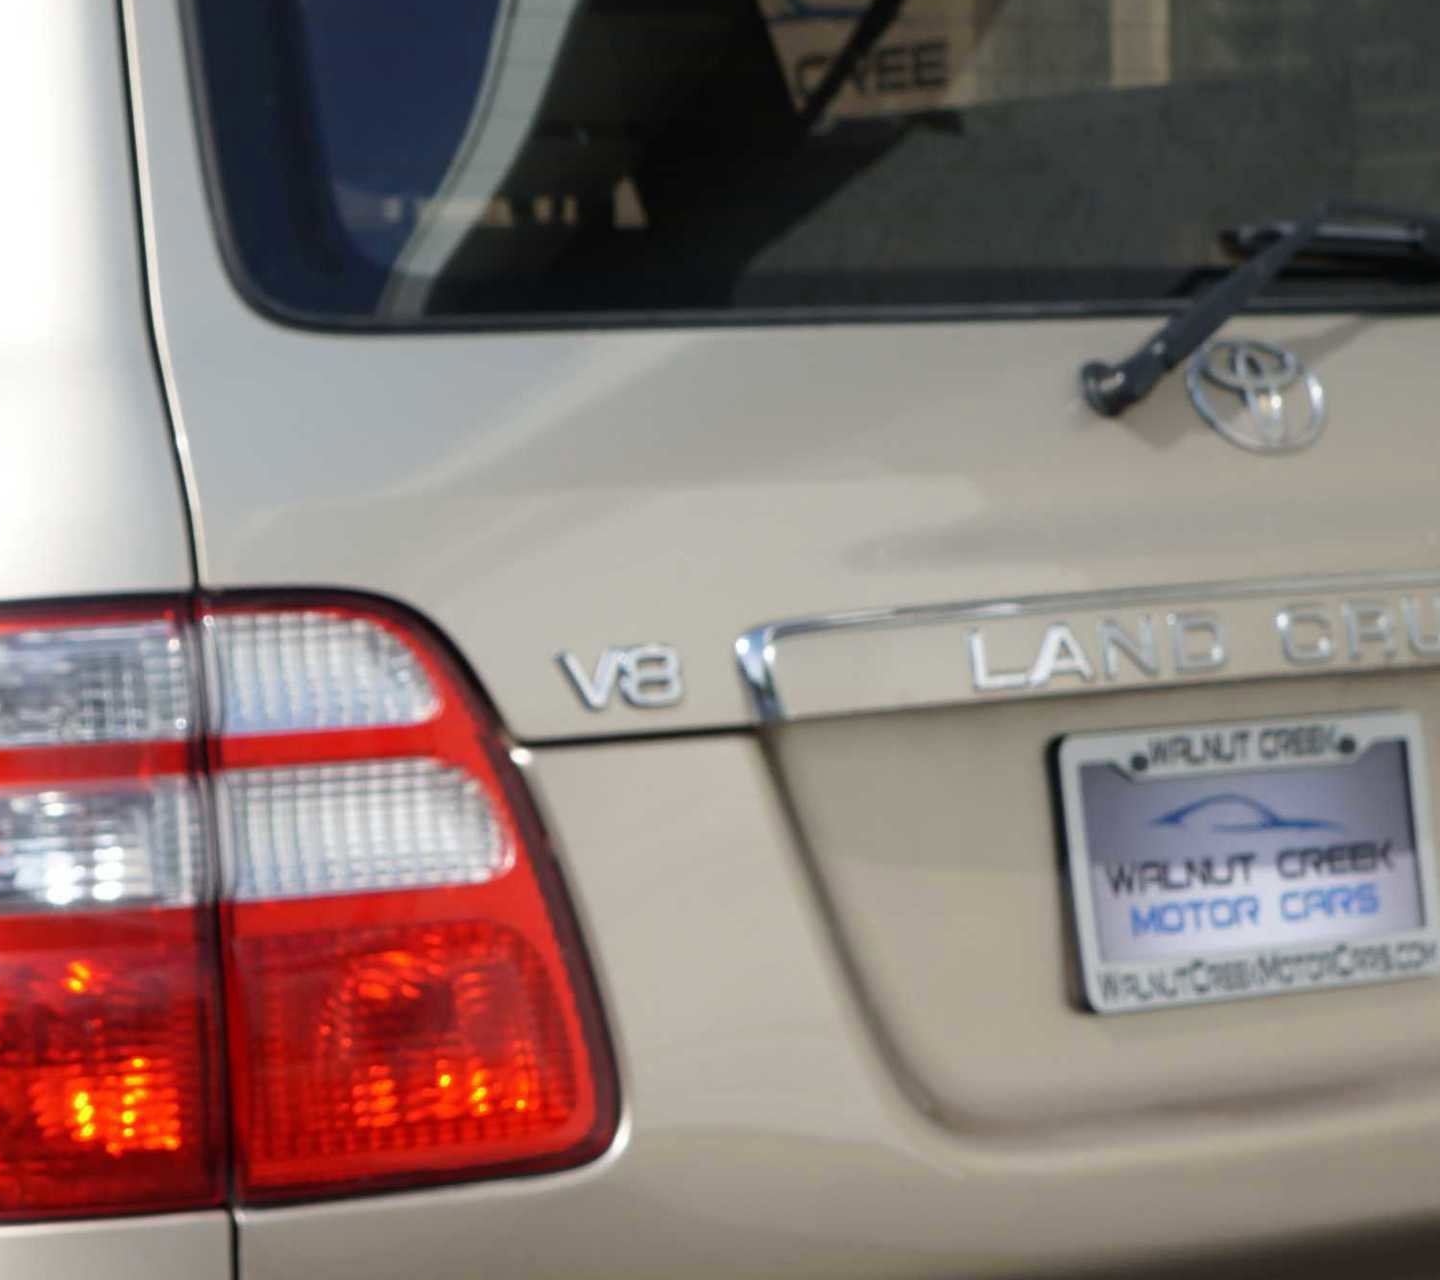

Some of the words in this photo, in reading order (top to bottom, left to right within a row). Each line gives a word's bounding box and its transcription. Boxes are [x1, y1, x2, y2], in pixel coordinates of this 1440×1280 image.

[556, 642, 684, 712] V8
[967, 613, 1227, 691] LAND
[1149, 730, 1249, 765] WALNUT
[1259, 722, 1342, 759] CREEK
[1106, 852, 1257, 895] WALNUT
[1276, 839, 1396, 881] CREEK
[1130, 894, 1260, 937] MOTOR
[1280, 883, 1381, 922] CARS
